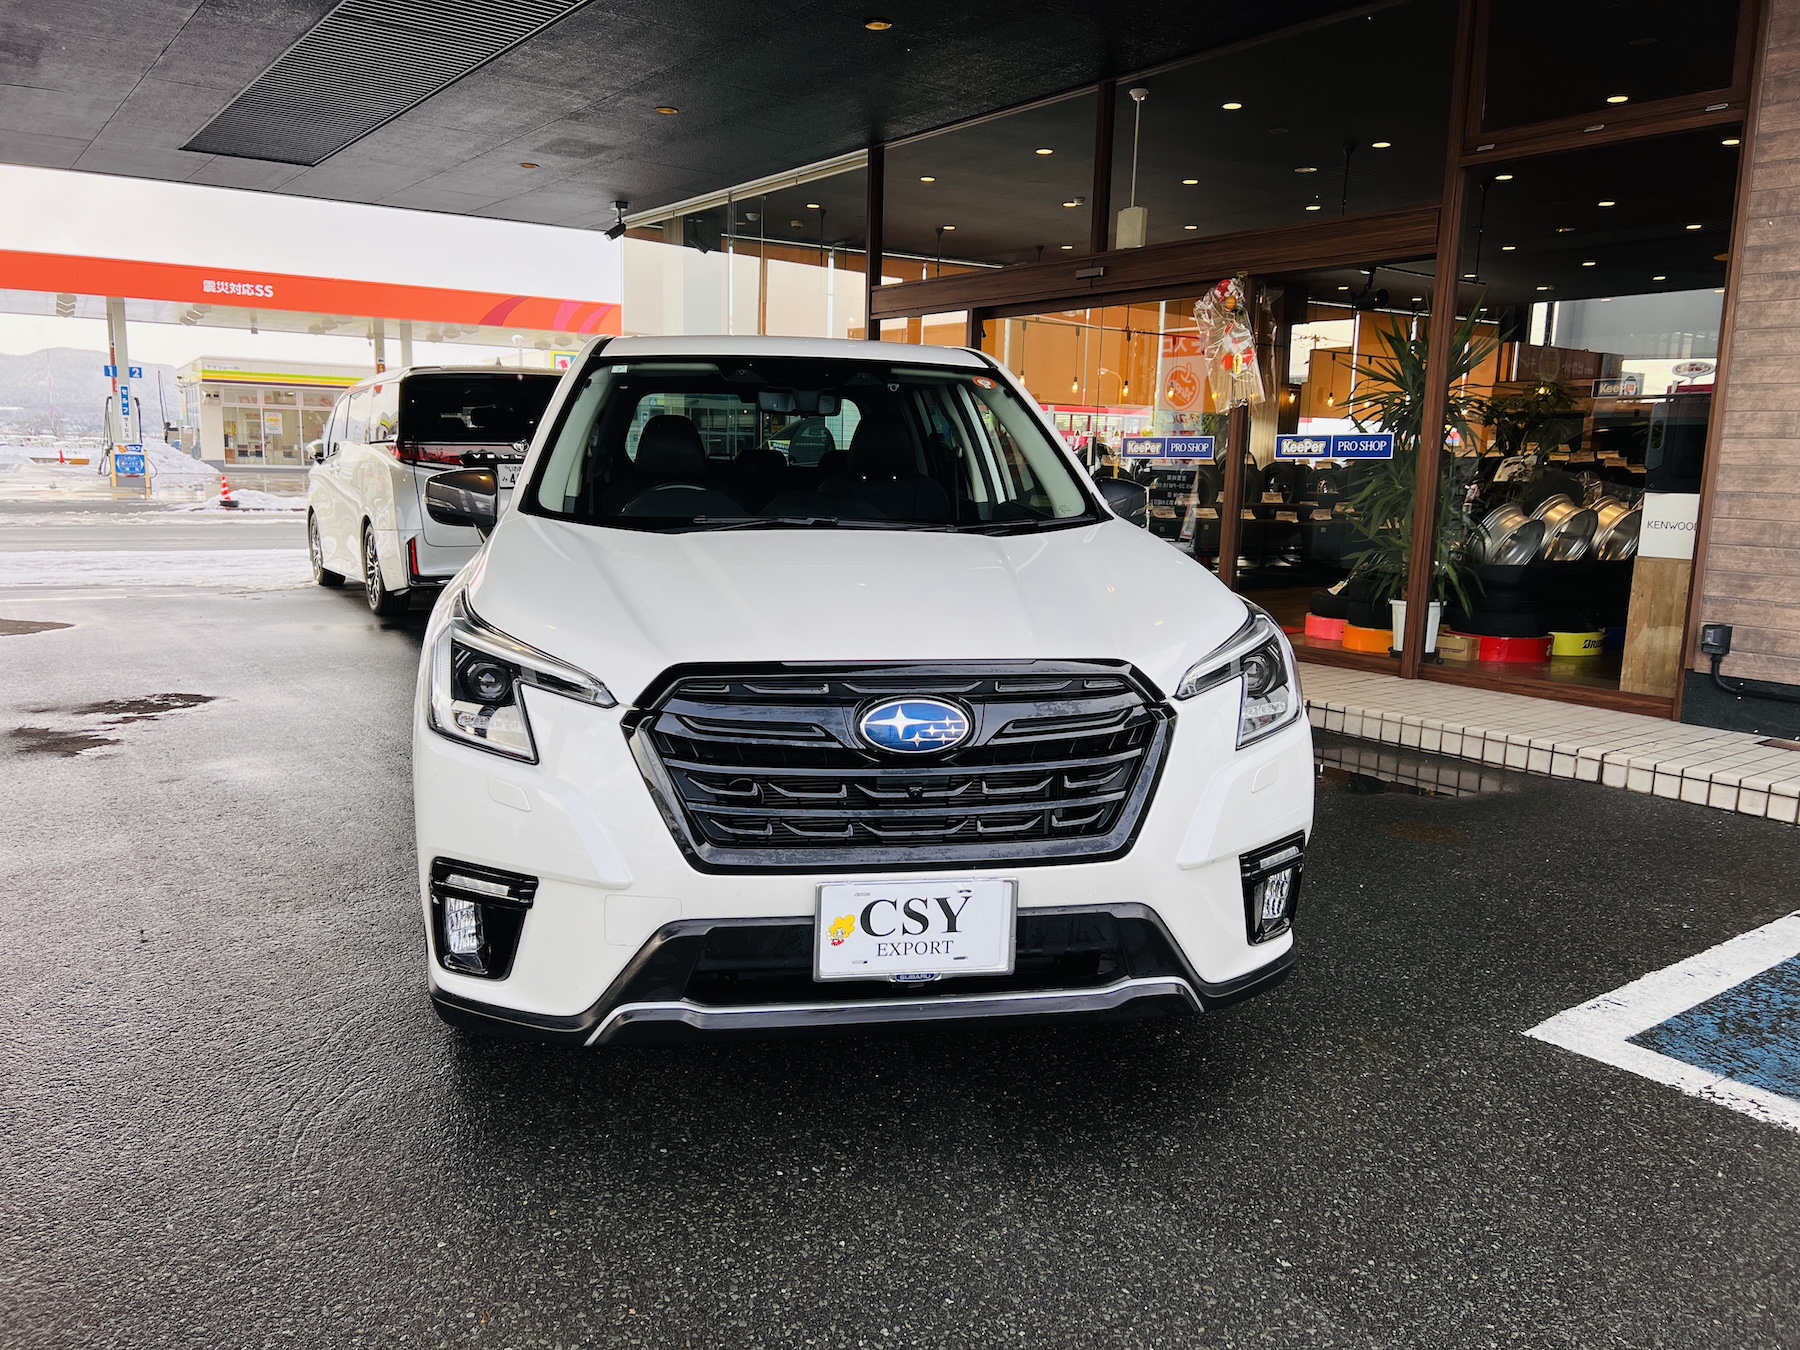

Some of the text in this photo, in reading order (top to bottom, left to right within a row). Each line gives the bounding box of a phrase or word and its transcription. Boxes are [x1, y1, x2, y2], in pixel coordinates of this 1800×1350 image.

[203, 280, 274, 298] 震災対応SS
[131, 368, 140, 378] 2
[121, 387, 129, 413] セルフ
[1127, 441, 1210, 454] KeePer PRO SHOP
[1281, 439, 1387, 455] KeePer PRO SHOP
[860, 896, 972, 937] CSY
[876, 940, 954, 957] EXPORT
